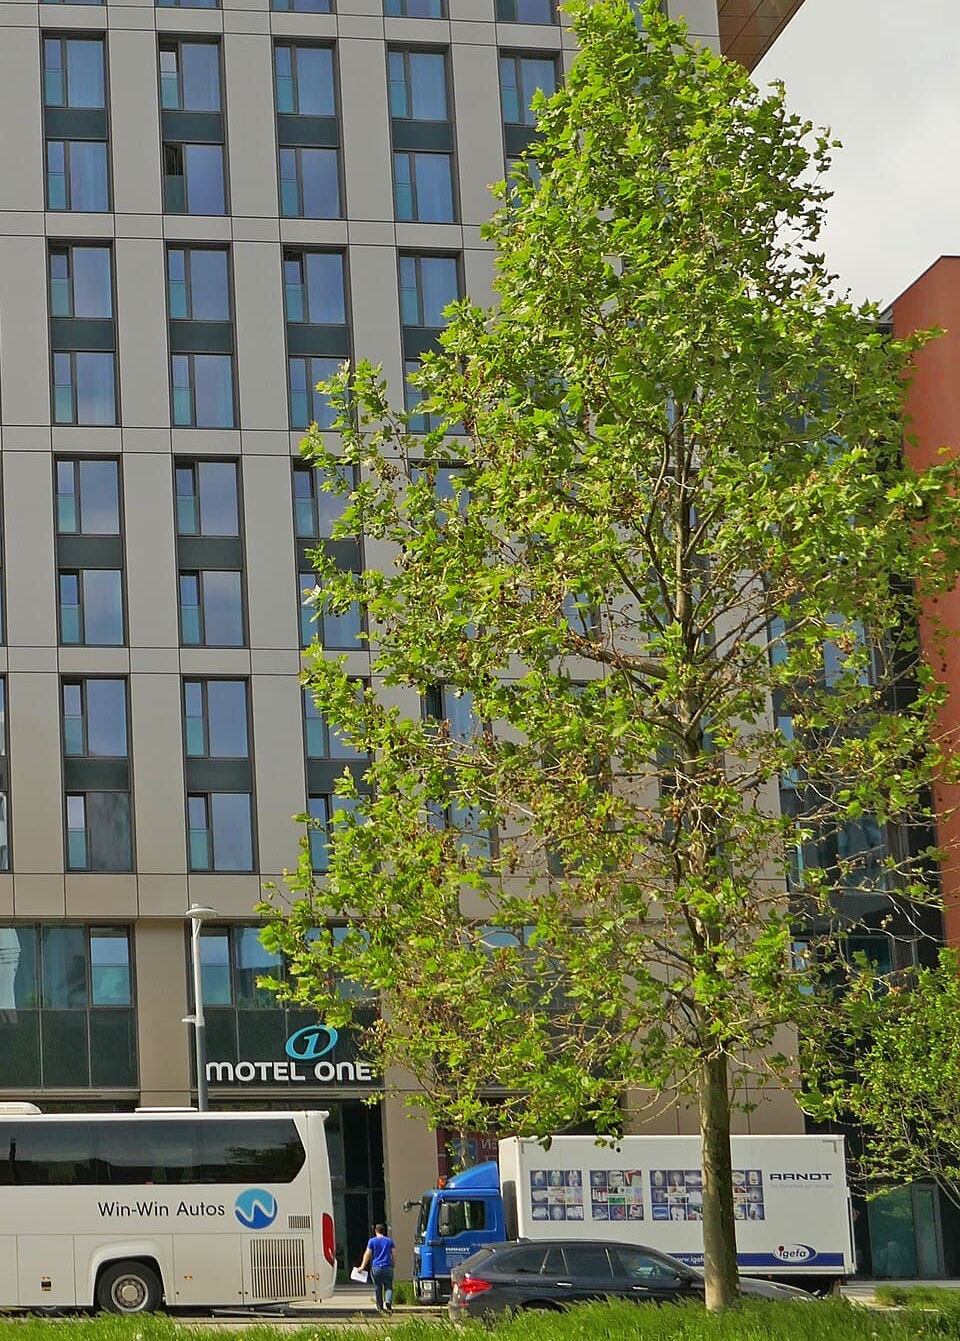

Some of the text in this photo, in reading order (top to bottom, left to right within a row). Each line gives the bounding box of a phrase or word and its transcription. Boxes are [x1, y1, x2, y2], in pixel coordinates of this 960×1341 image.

[206, 1061, 306, 1082] MOTEL
[98, 1201, 226, 1217] Win-Win Autos
[778, 1245, 807, 1260] igefa
